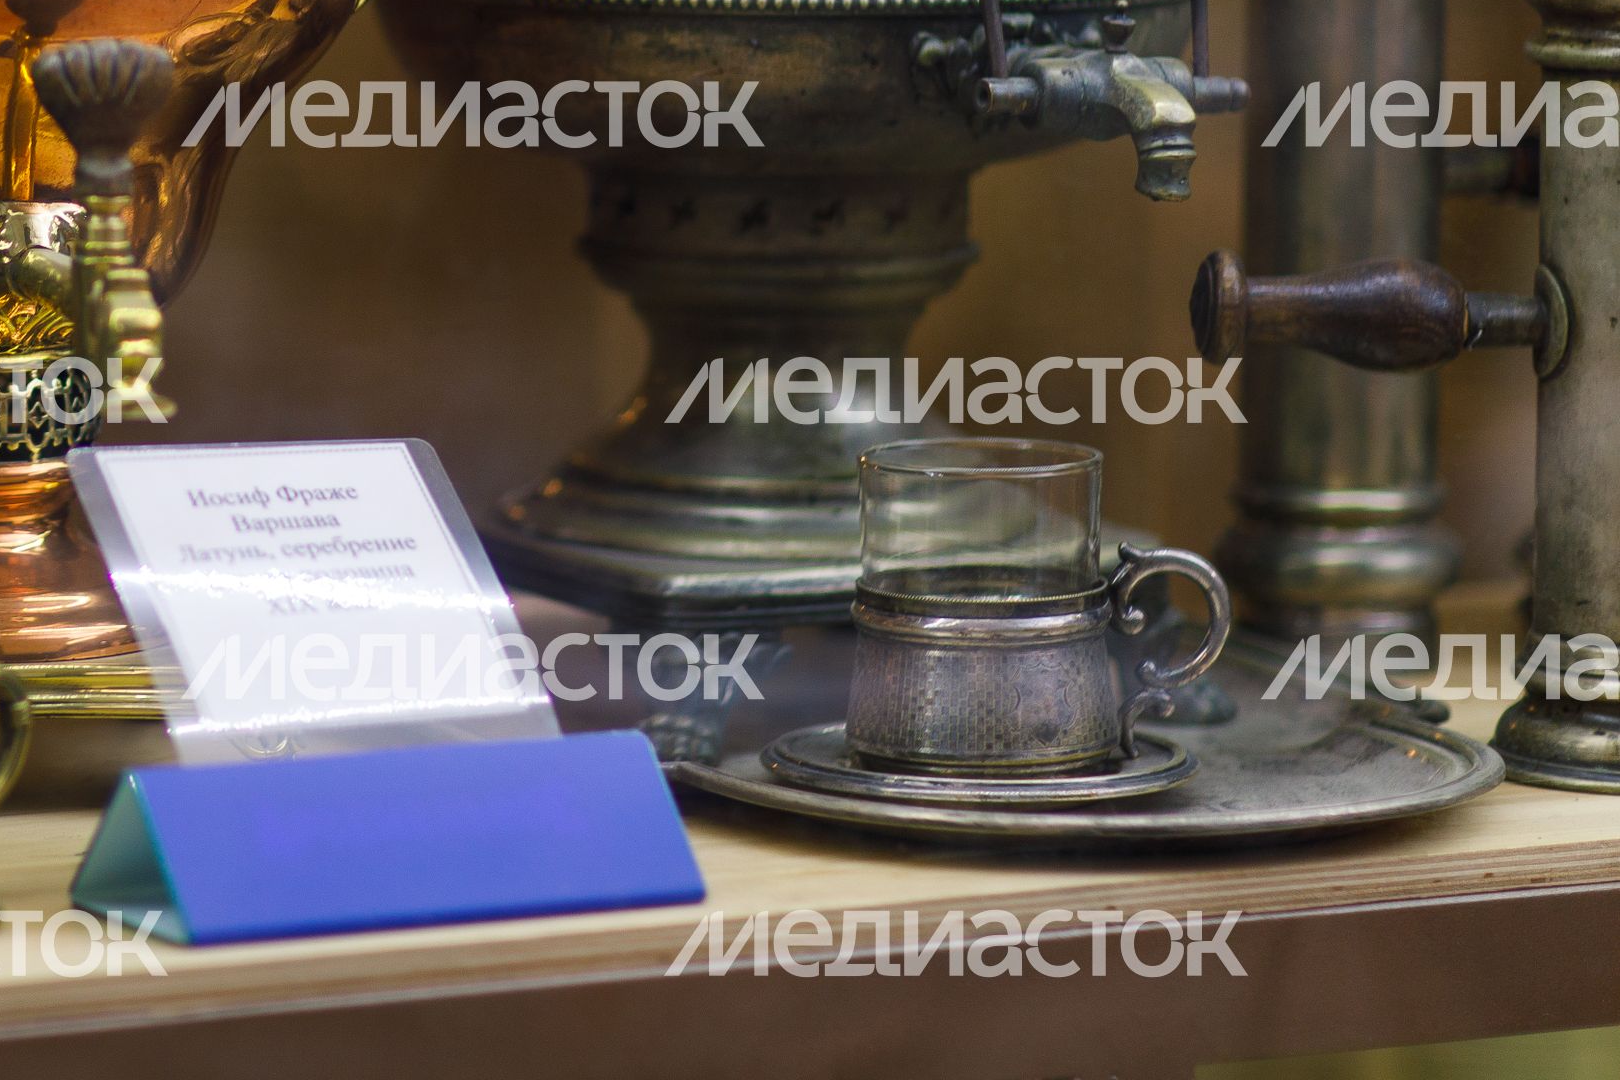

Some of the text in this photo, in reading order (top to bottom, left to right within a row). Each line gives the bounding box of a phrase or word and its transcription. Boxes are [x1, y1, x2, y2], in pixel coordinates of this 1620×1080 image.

[186, 484, 359, 509] Иосиф Фраже
[230, 513, 342, 536] Варшава
[178, 536, 418, 565] Латунь, серебрение
